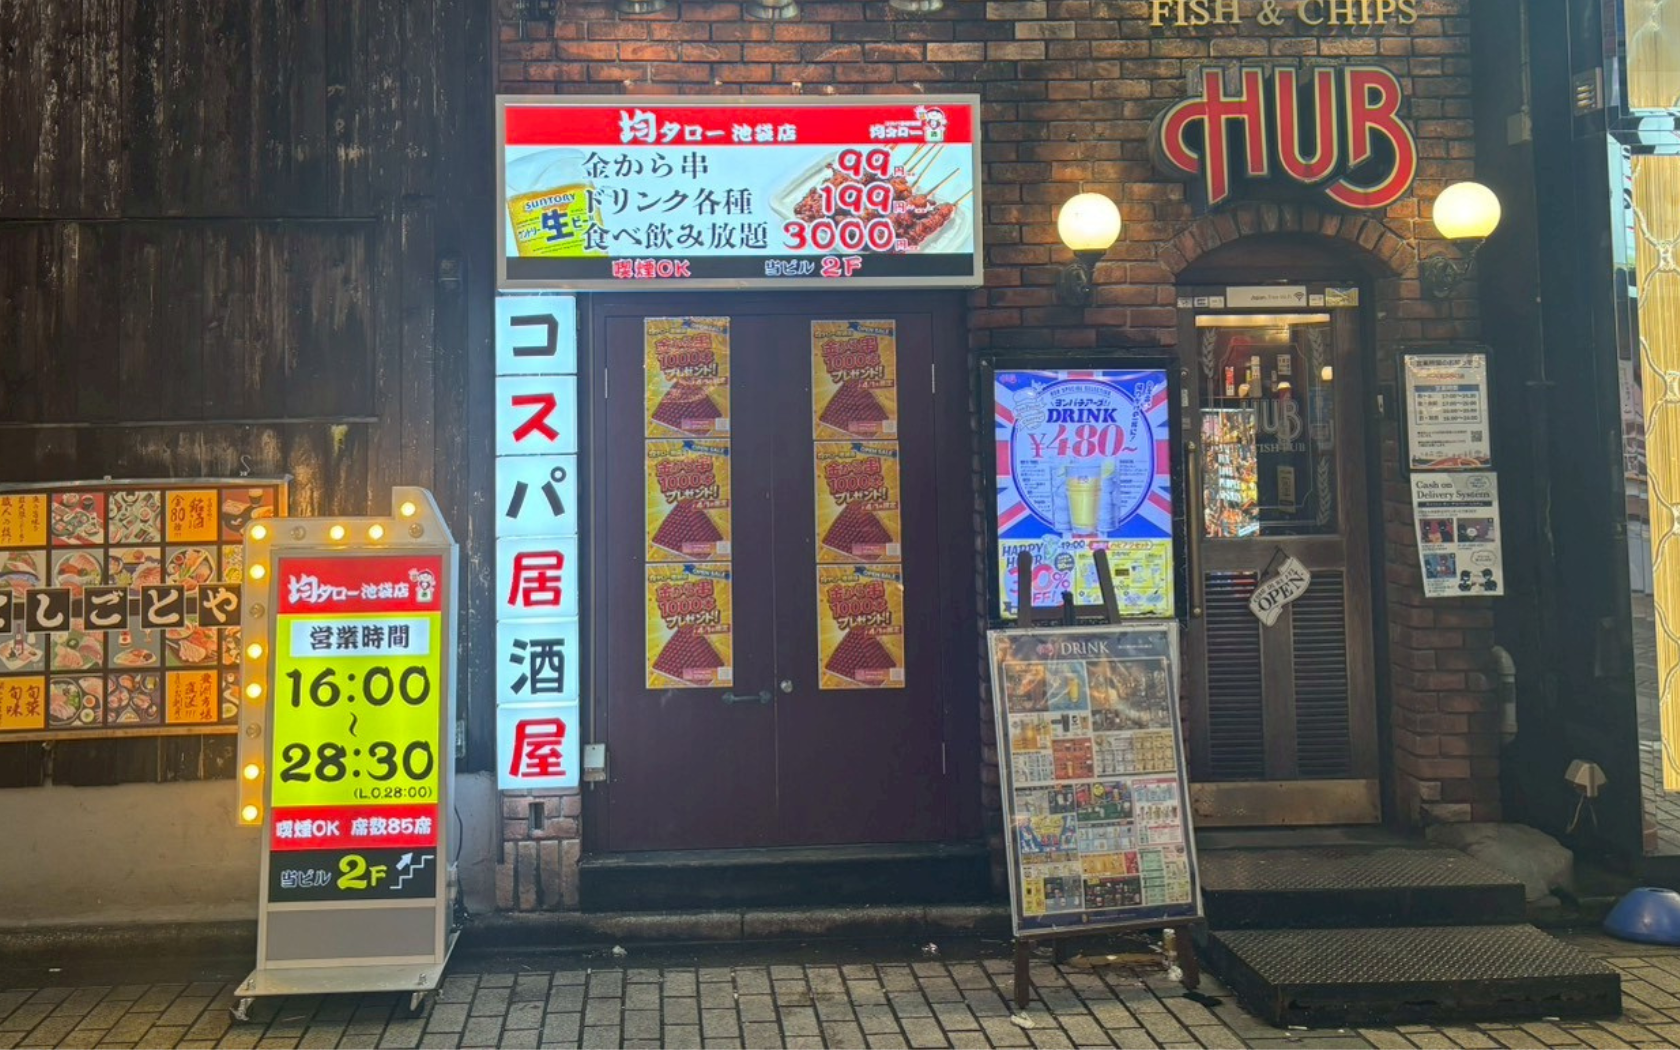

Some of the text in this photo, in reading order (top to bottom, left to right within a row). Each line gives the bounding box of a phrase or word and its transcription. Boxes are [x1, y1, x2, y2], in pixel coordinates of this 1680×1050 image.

[1150, 0, 1418, 26] FISH & CHIPS
[1161, 66, 1417, 208] HUB
[582, 151, 709, 180] 金から串
[586, 187, 753, 215] ドリンク各種
[583, 222, 768, 250] 食べ飲み放題
[611, 258, 691, 278] 喫煙OK
[1046, 408, 1118, 423] DRINK
[1416, 480, 1439, 489] Cash
[1417, 490, 1490, 501] Delivery System
[1006, 554, 1043, 568] HR
[1258, 570, 1305, 611] OPEN
[309, 624, 410, 651] 営業時間
[1061, 640, 1110, 656] DRINK
[286, 665, 431, 707] 16:00
[280, 740, 434, 782] 28:30
[275, 819, 341, 838] 喫煙OK
[336, 853, 388, 890] 2F
